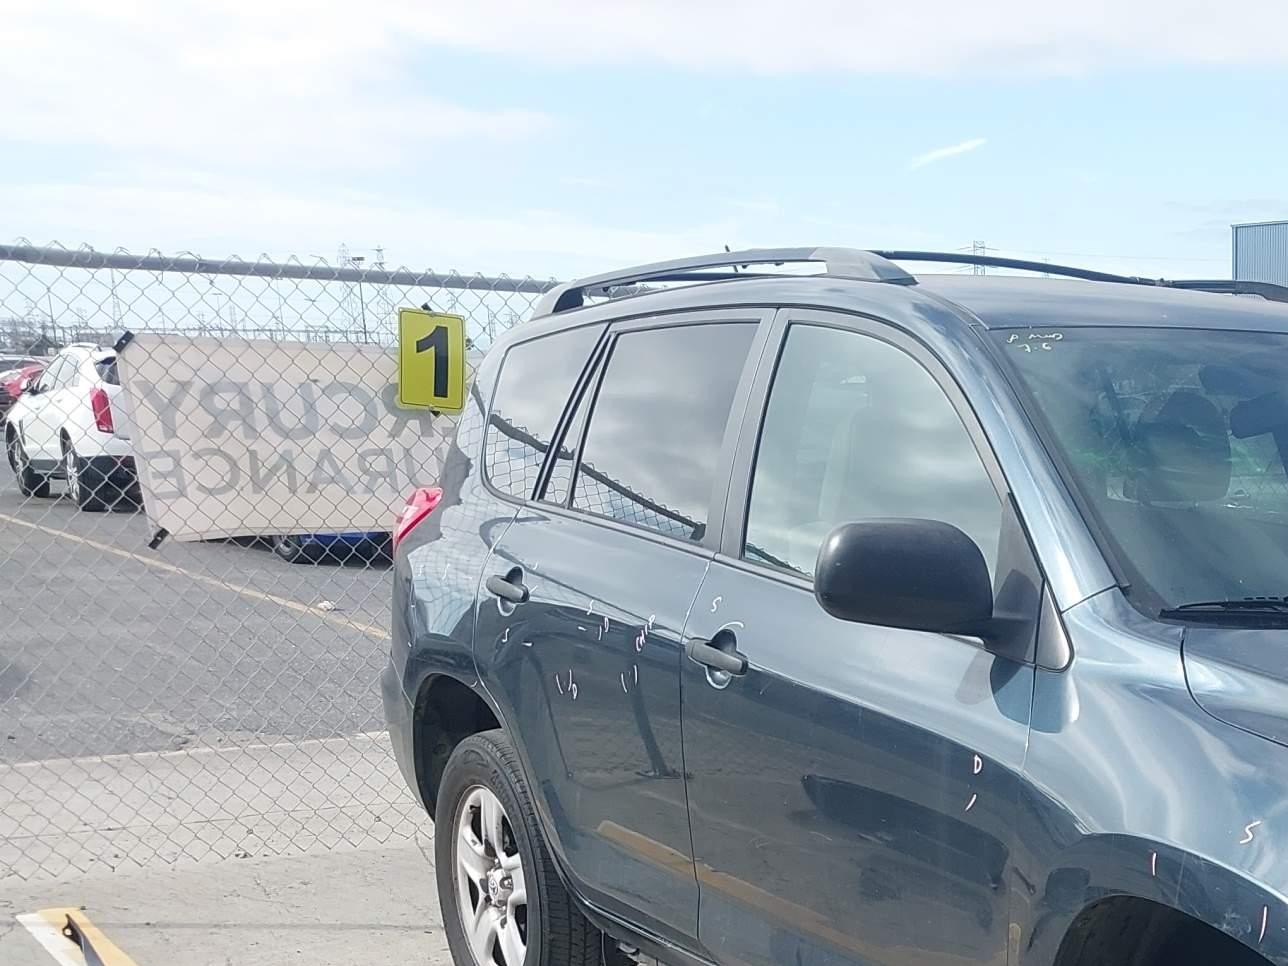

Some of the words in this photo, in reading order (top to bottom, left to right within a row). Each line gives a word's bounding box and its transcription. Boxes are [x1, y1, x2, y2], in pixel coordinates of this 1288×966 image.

[416, 325, 449, 398] 1
[973, 754, 983, 775] D
[1239, 820, 1262, 844] S
